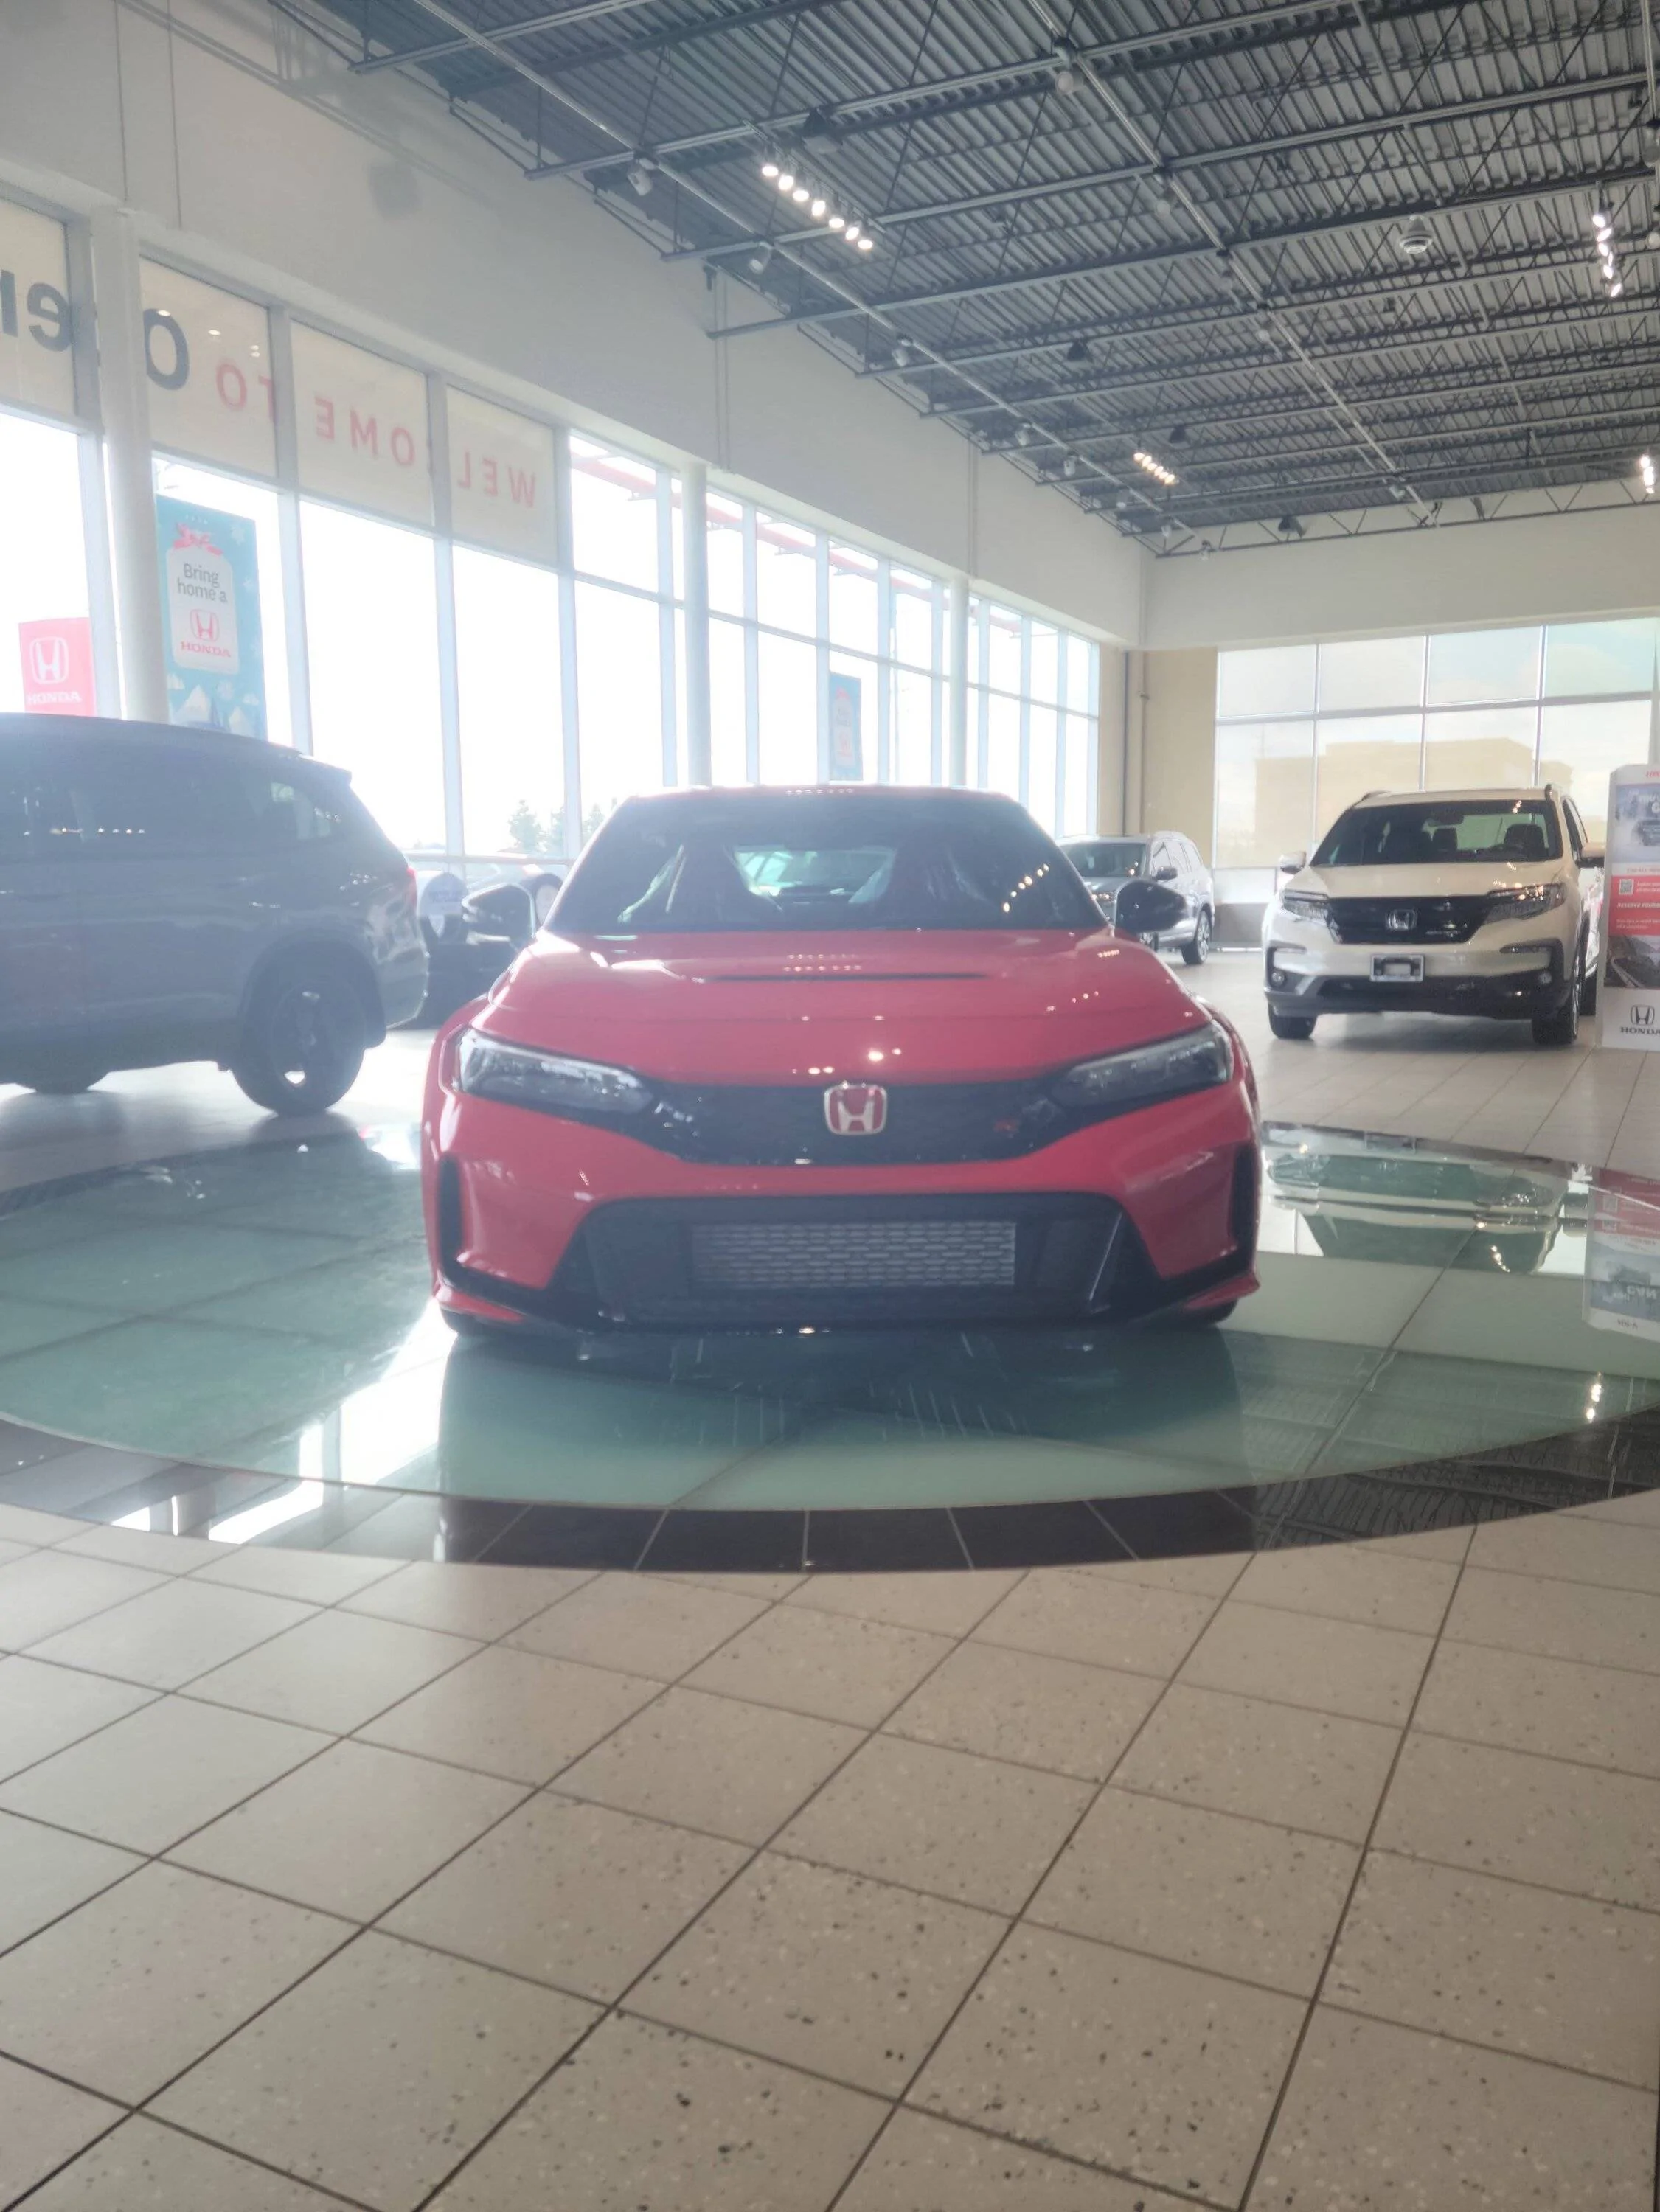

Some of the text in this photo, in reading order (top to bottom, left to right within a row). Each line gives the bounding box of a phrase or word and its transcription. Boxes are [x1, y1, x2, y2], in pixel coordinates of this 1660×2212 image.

[184, 563, 220, 588] Bring
[177, 577, 228, 603] home a
[180, 641, 232, 658] HONDA
[27, 691, 82, 705] HONDA
